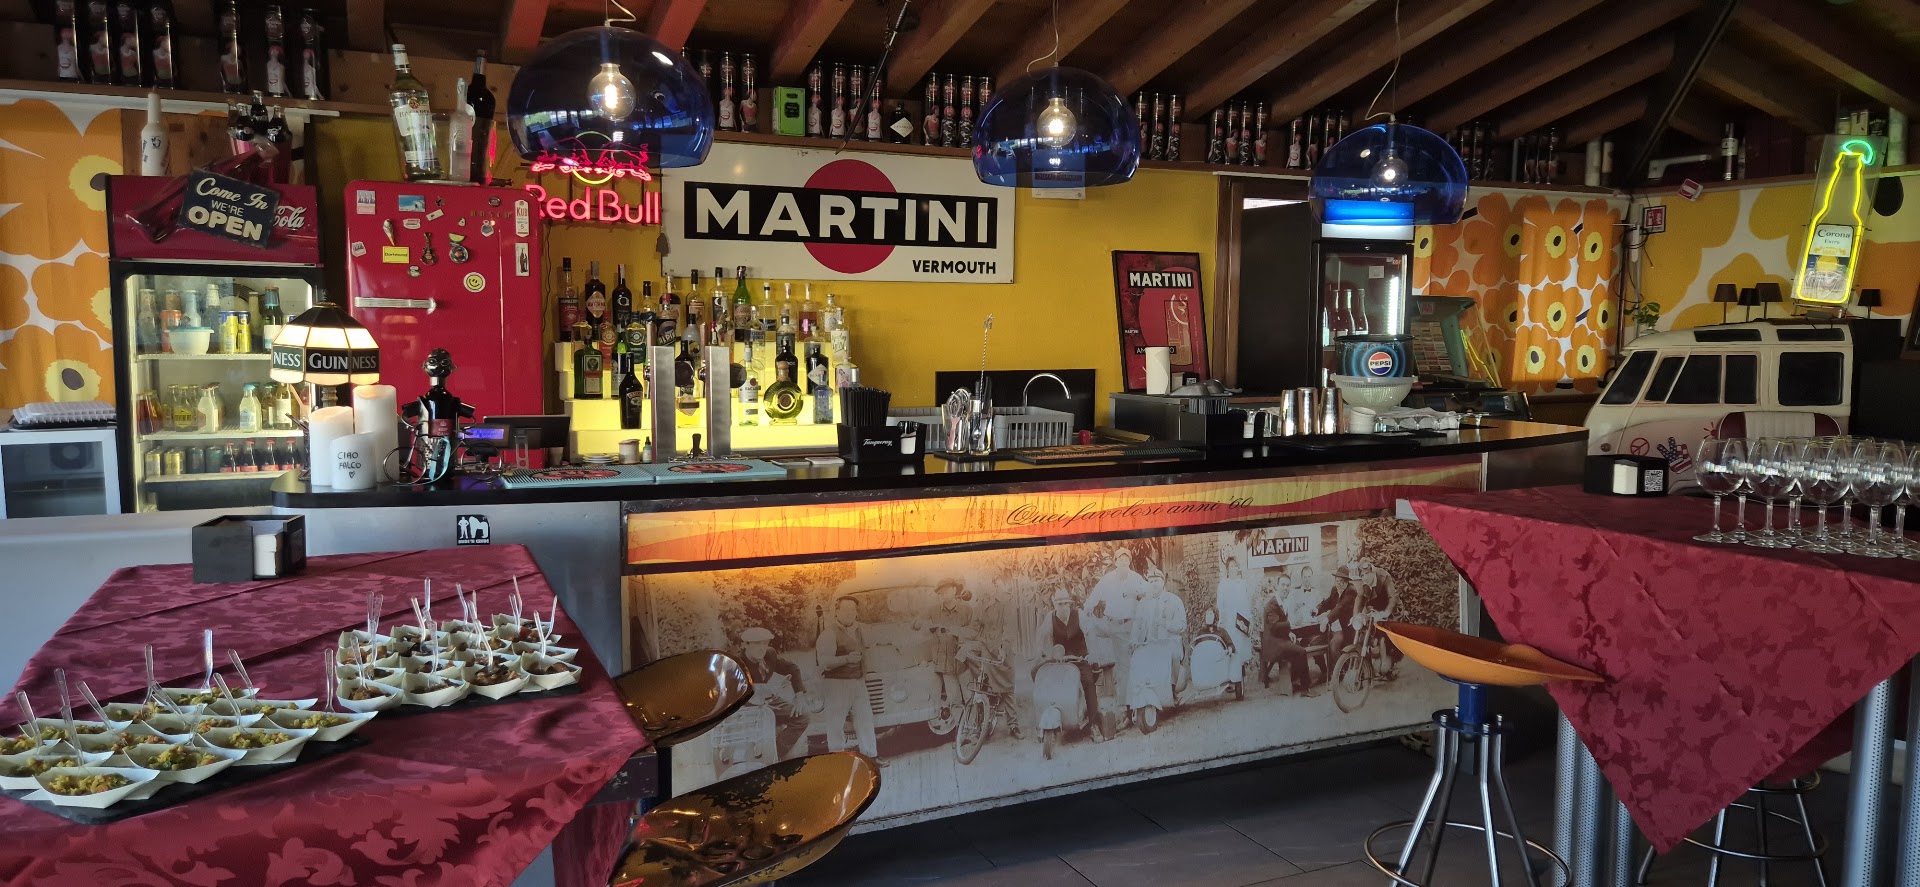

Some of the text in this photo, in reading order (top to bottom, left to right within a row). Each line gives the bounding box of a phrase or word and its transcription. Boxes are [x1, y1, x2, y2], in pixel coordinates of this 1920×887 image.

[196, 177, 268, 210] Come In
[211, 200, 245, 217] WE'RE
[525, 184, 660, 224] Red Bull
[188, 206, 263, 241] OPEN
[696, 187, 989, 243] MARTINI
[1817, 229, 1851, 238] Corona
[912, 259, 997, 275] VERMOUTH
[1129, 271, 1193, 288] MARTINI
[273, 351, 301, 368] NESS
[863, 438, 893, 447] Tanqueray
[338, 451, 359, 460] CIAO
[339, 461, 362, 469] FALCO
[1006, 503, 1069, 525] Quei
[1062, 499, 1162, 528] favolosi
[1166, 501, 1221, 514] anni
[1253, 537, 1308, 556] MARTINI
